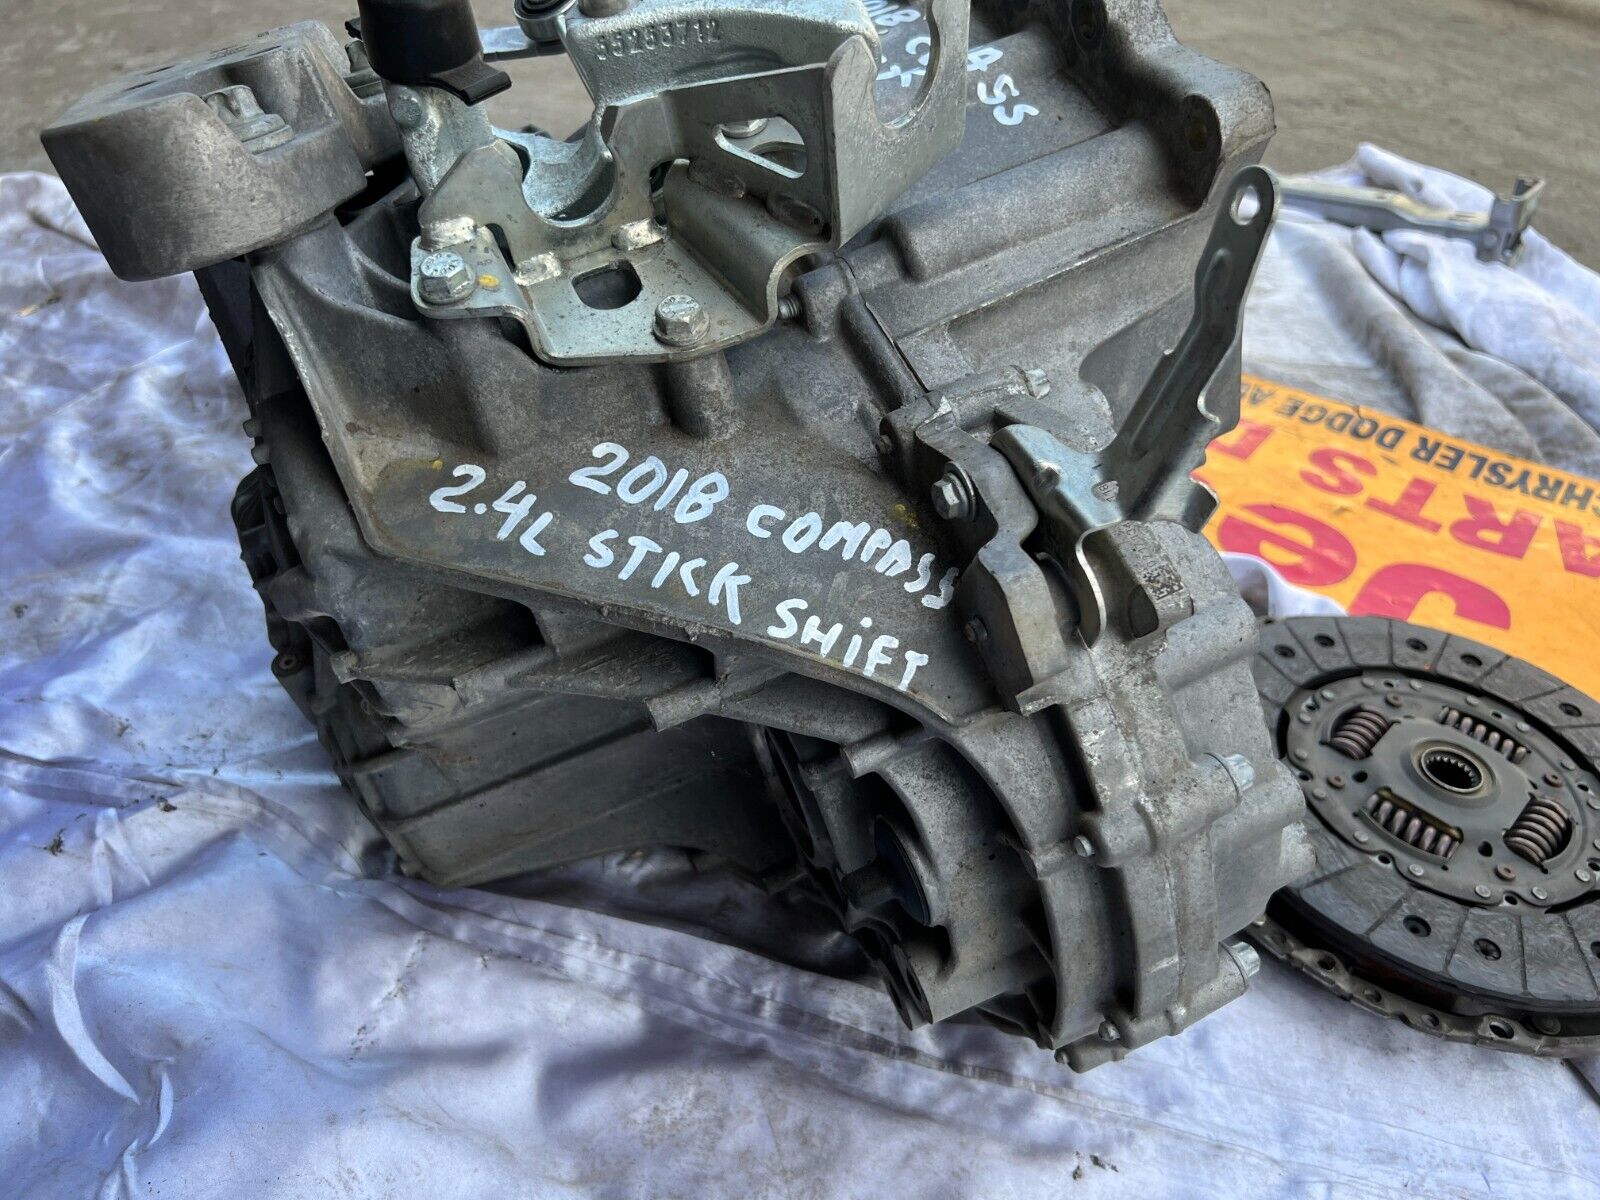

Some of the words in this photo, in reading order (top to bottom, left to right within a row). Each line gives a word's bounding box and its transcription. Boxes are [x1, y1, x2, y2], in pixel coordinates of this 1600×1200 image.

[1273, 396, 1406, 451] DODGE
[568, 442, 732, 525] 2018
[1299, 447, 1600, 578] ARTS
[429, 464, 553, 557] 2.4L
[583, 529, 752, 626] STICK
